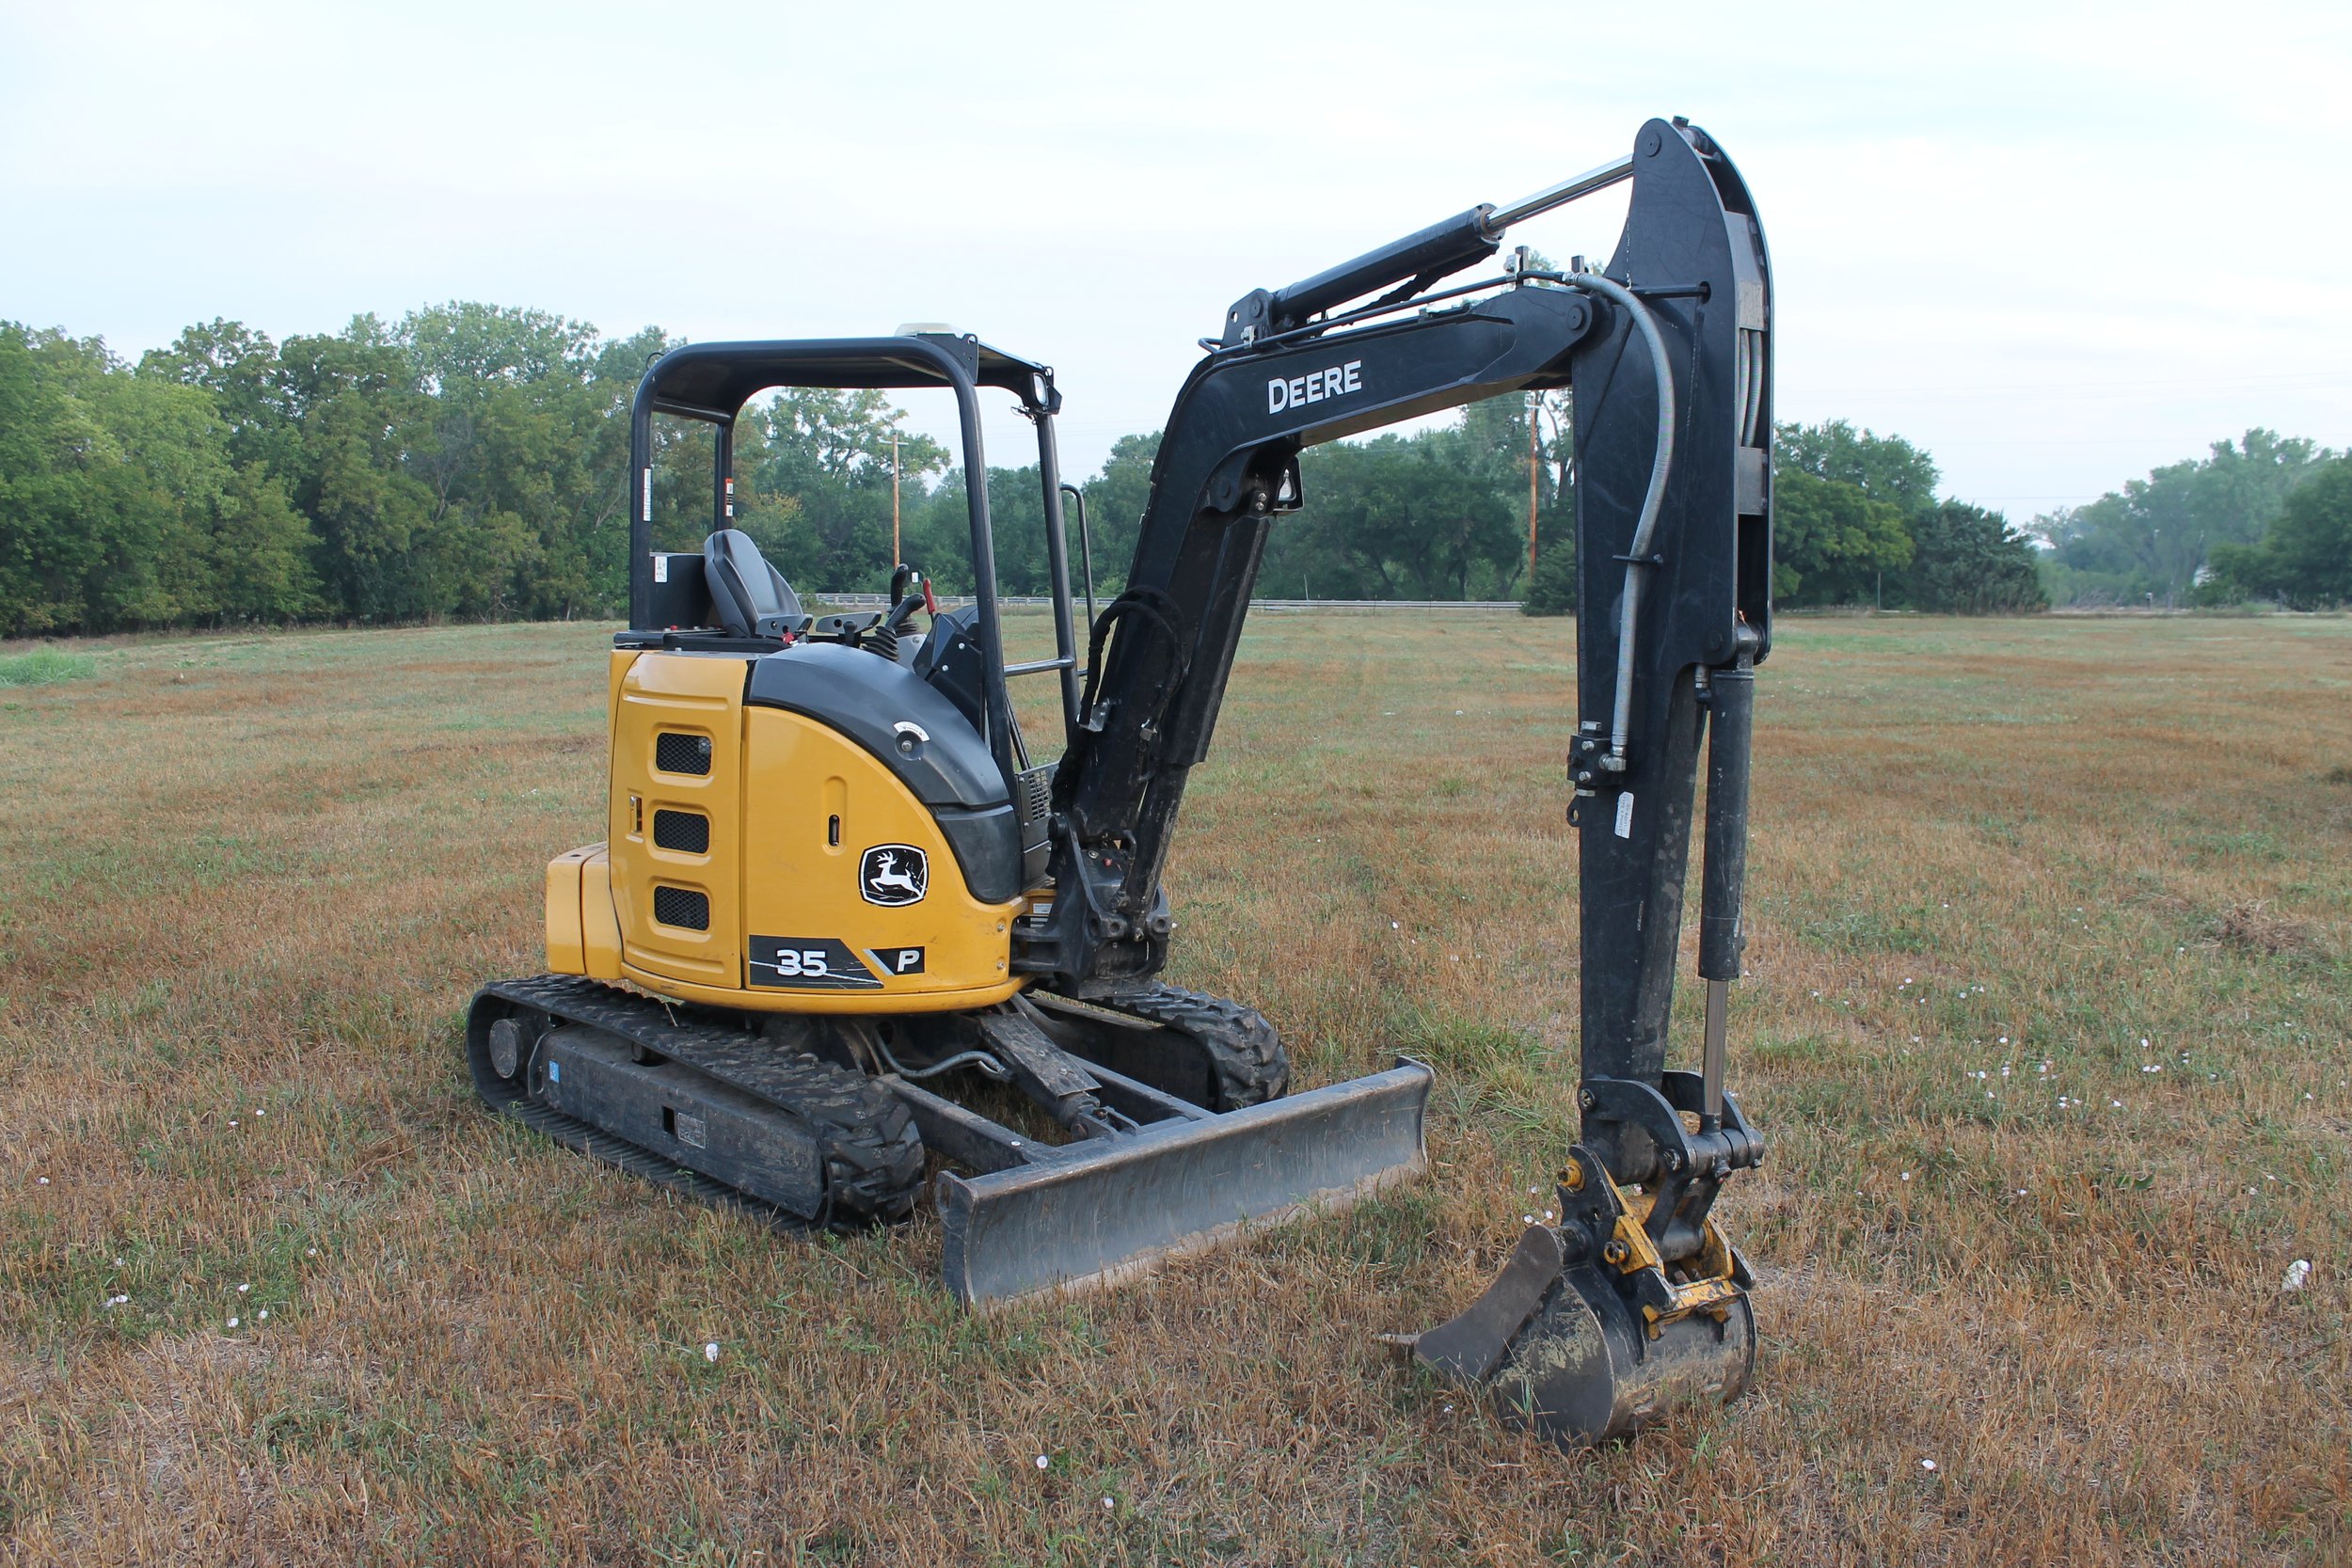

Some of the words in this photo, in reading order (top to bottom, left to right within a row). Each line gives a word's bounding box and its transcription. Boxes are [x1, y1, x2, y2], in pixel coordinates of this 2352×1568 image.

[1268, 359, 1362, 415] DEERE
[776, 949, 828, 977] 35
[897, 950, 921, 973] P
